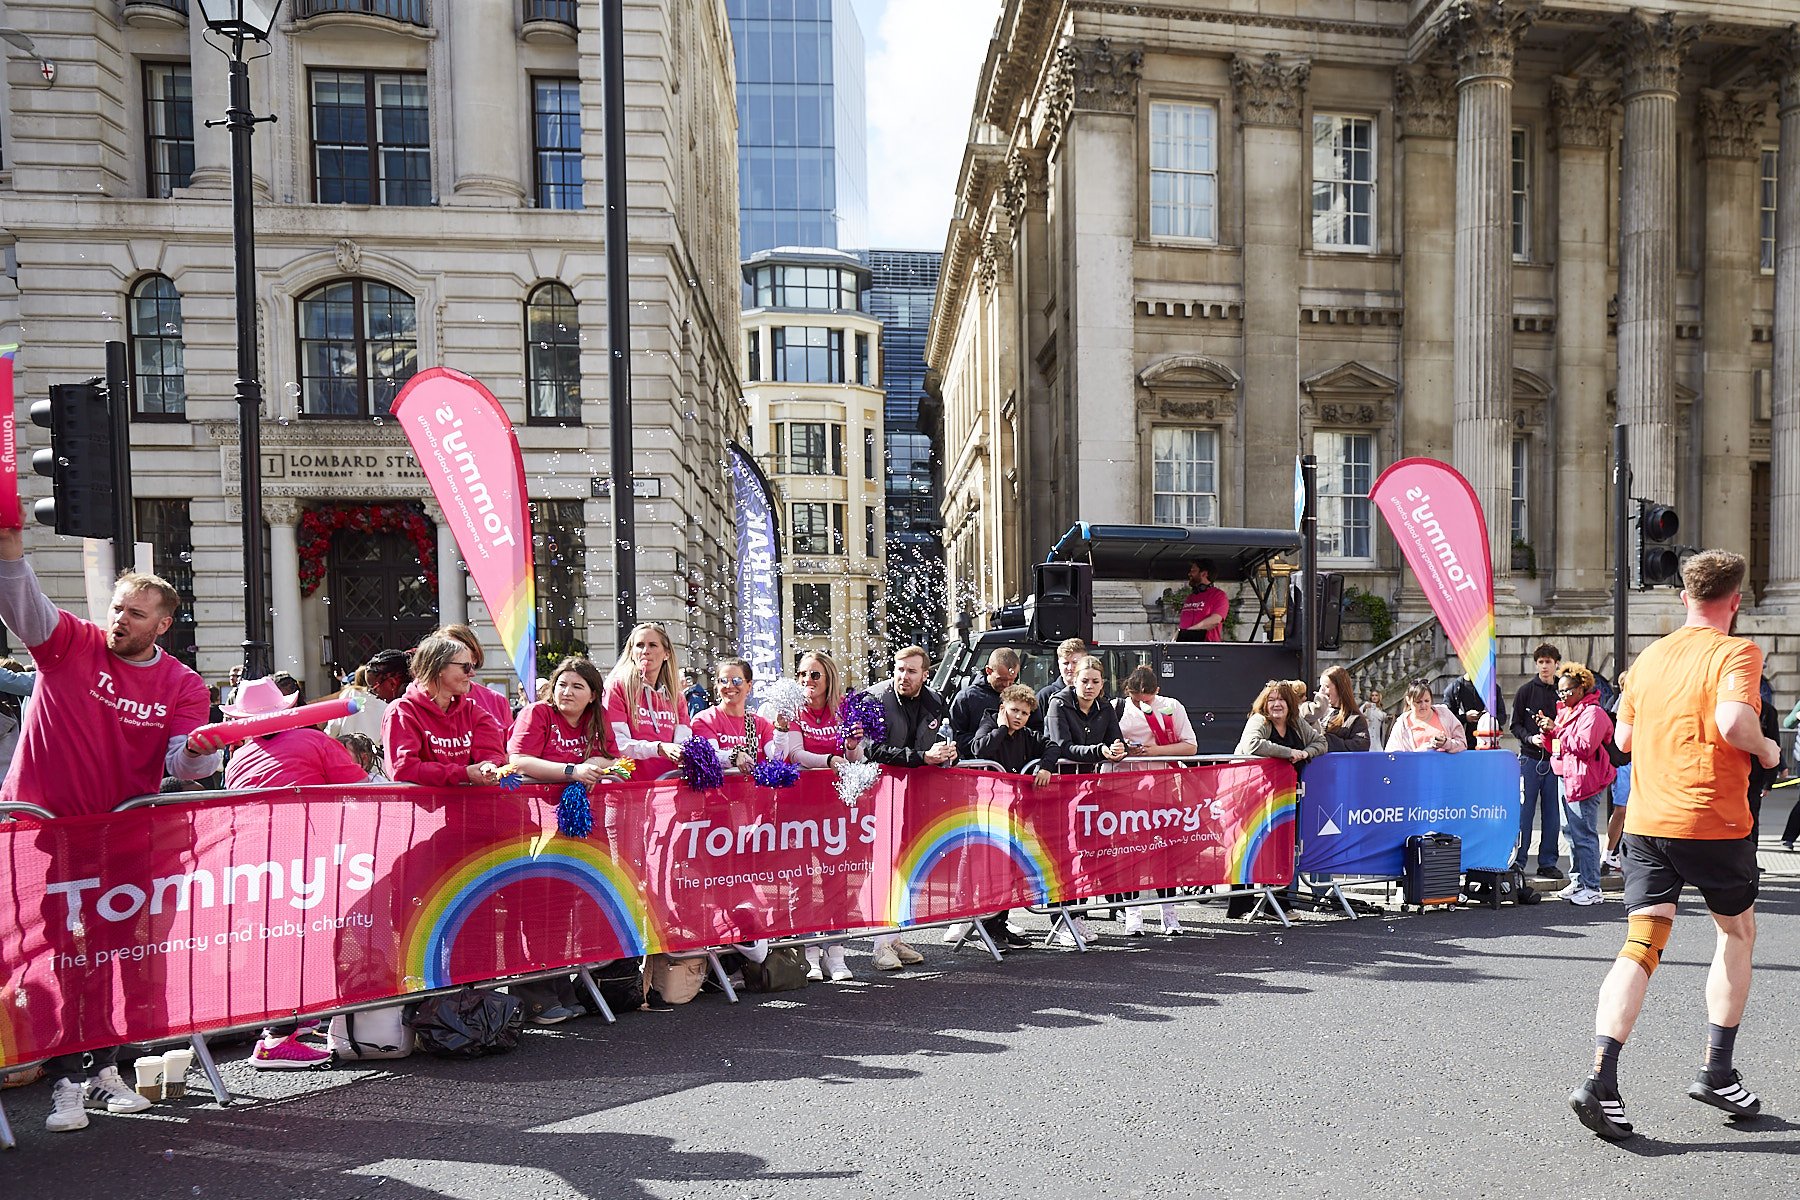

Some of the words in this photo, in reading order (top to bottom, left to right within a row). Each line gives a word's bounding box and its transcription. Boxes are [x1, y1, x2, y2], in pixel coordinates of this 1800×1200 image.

[1, 411, 17, 473] Tommy's
[290, 455, 378, 468] LOMBARD
[386, 455, 422, 468] STR
[291, 470, 354, 478] RESTAURANT
[366, 470, 385, 478] BAR
[124, 716, 141, 727] baby
[1077, 798, 1226, 837] Tommy's
[1348, 807, 1404, 826] MOORE
[1407, 806, 1466, 824] Kingston
[1470, 804, 1507, 820] Smith
[681, 807, 877, 859] Tommy's
[1097, 844, 1148, 858] pregnancy
[1190, 831, 1223, 842] charity
[46, 844, 376, 931] Tommy's
[675, 877, 700, 890] The
[704, 871, 775, 890] pregnancy
[778, 865, 803, 879] and
[806, 863, 836, 877] baby
[838, 859, 875, 874] charity
[48, 952, 87, 972] The
[95, 932, 209, 966] pregnancy
[214, 925, 253, 946] and
[258, 916, 306, 941] baby
[312, 910, 375, 934] charity
